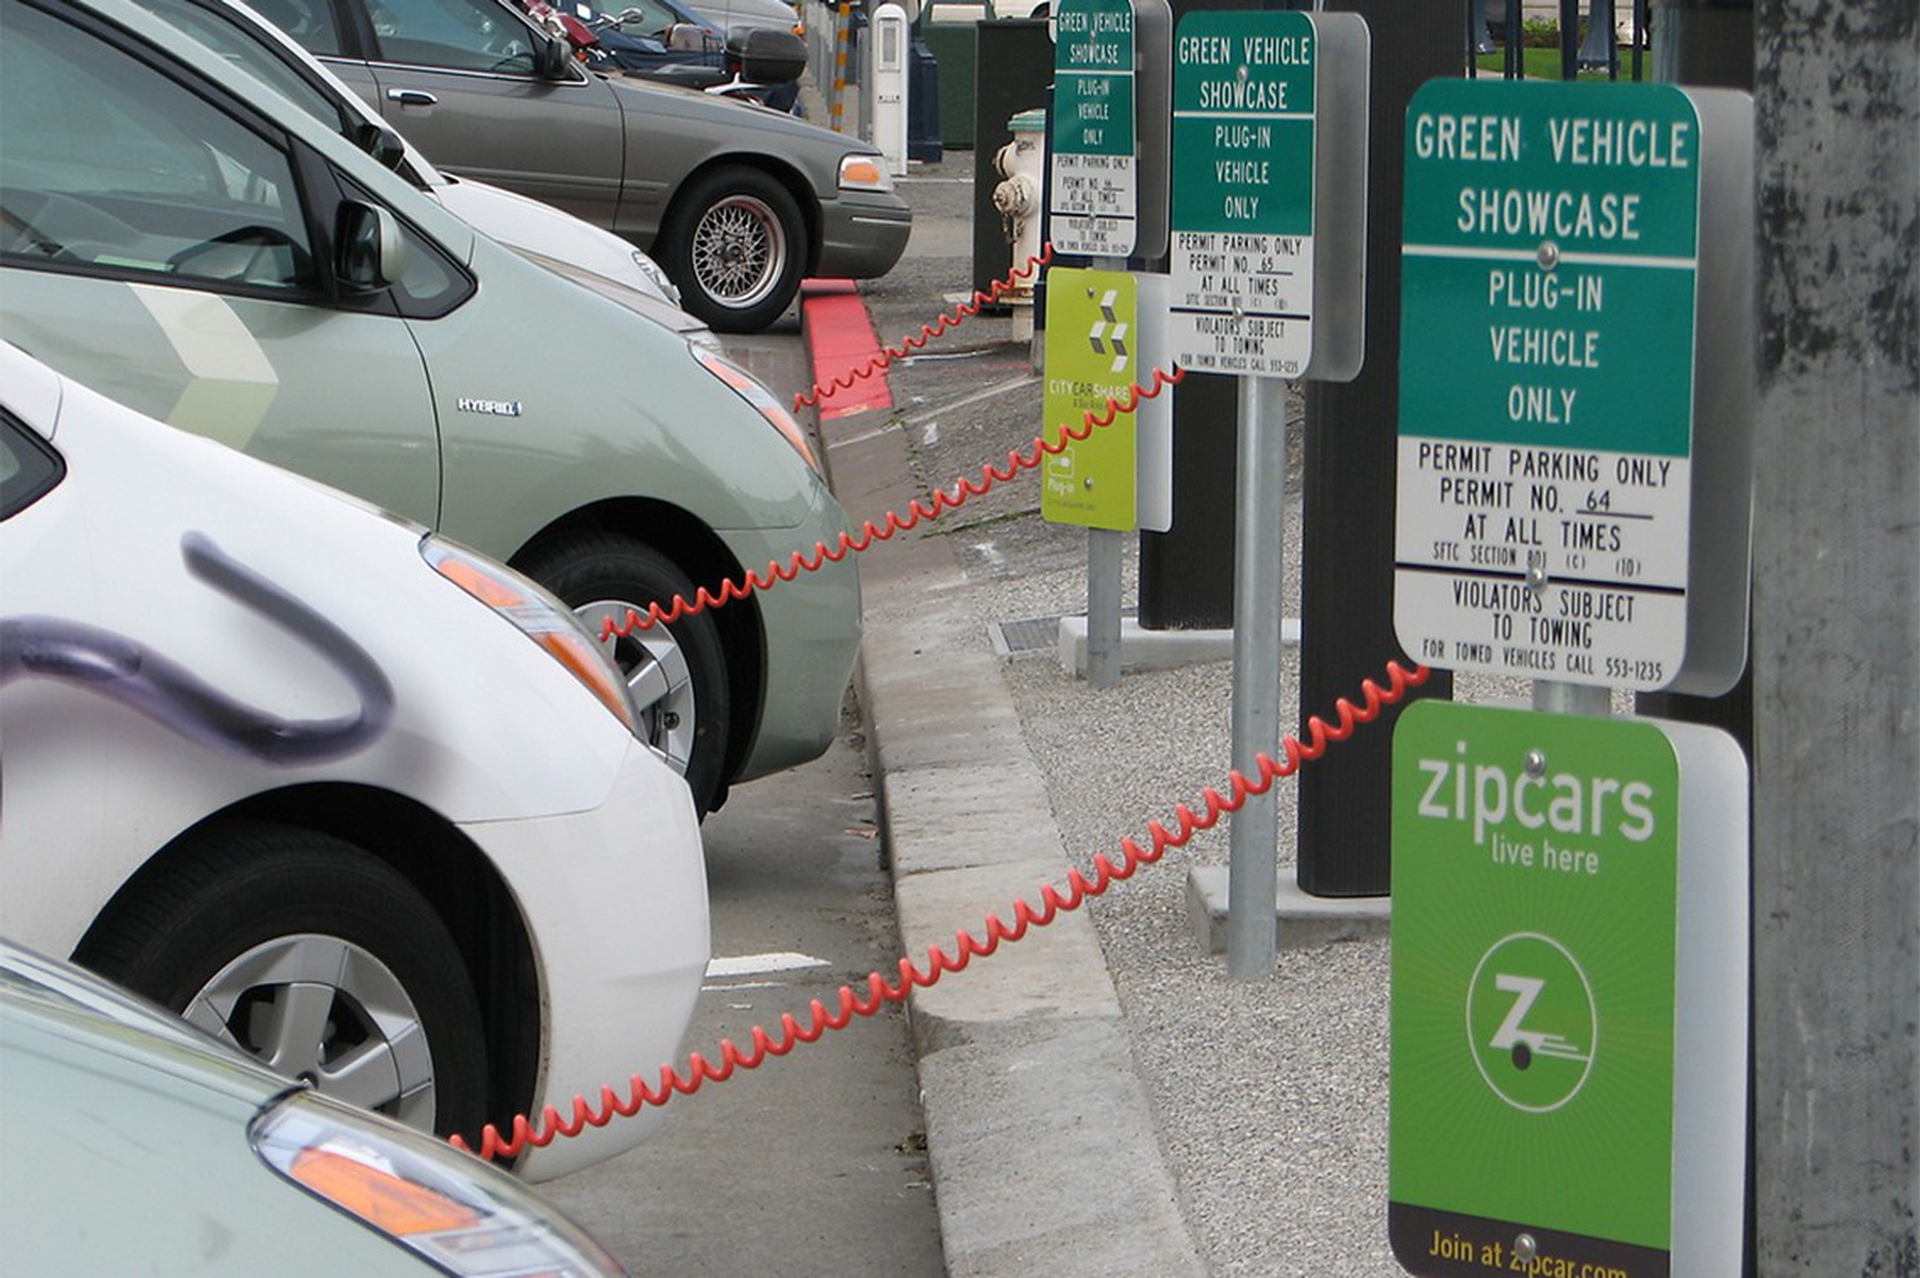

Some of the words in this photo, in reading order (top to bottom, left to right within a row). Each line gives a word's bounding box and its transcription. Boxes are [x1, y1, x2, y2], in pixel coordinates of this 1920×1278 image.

[1060, 12, 1088, 32] GREEN
[1093, 12, 1130, 32] VEHICLE
[1070, 44, 1118, 64] SHOWCASE
[1179, 37, 1230, 64] GREEN
[1244, 38, 1310, 64] VEHICLE
[1078, 79, 1109, 95] PLUG-IN
[1200, 81, 1287, 109] SHOWCASE
[1078, 104, 1109, 120] VEHICLE
[1083, 129, 1103, 145] ONLY
[1215, 126, 1270, 148] PLUG-IN
[1415, 114, 1520, 162] GREEN
[1550, 118, 1689, 168] VEHICLE
[1216, 161, 1269, 184] VEHICLE
[1225, 196, 1258, 218] ONLY
[1458, 188, 1640, 240] SHOWCASE
[1178, 233, 1215, 250] PERMIT
[1223, 235, 1268, 254] PARKING
[1274, 238, 1302, 256] ONLY
[1190, 254, 1226, 271] PERMIT
[1202, 276, 1212, 292] AT
[1221, 276, 1240, 294] ALL
[1248, 278, 1278, 296] TIMES
[1489, 270, 1602, 312] PLUG-IN
[1196, 317, 1240, 335] VIOLATORS
[1248, 320, 1284, 338] SUBJECT
[1215, 336, 1225, 352] TO
[1233, 336, 1264, 356] TOWING
[1490, 326, 1600, 368] VEHICLE
[457, 398, 515, 415] HYBRID
[1508, 385, 1576, 424] ONLY
[1418, 443, 1492, 474] PERMIT
[1509, 450, 1599, 482] PARKING
[1616, 458, 1671, 488] ONLY
[1440, 478, 1514, 509] PERMIT
[1530, 485, 1564, 514] NO.
[1586, 490, 1611, 512] 64
[1464, 514, 1487, 540] AT
[1505, 517, 1542, 546] ALL
[1561, 521, 1621, 552] TIMES
[1470, 545, 1516, 566] SECTION
[1453, 580, 1542, 614] VIOLATORS
[1560, 590, 1634, 623] SUBJECT
[1493, 614, 1512, 640] TO
[1530, 618, 1592, 648] TOWING
[1422, 638, 1444, 659] FOR
[1456, 642, 1492, 664] TOWED
[1503, 648, 1556, 671] VEHICLES
[1566, 654, 1594, 674] CALL
[1606, 658, 1663, 682] 553-1235
[1418, 740, 1655, 842] zipcars
[1492, 832, 1535, 867] live
[1544, 839, 1600, 875] here
[1429, 1230, 1473, 1262] Join
[1481, 1242, 1502, 1268] at
